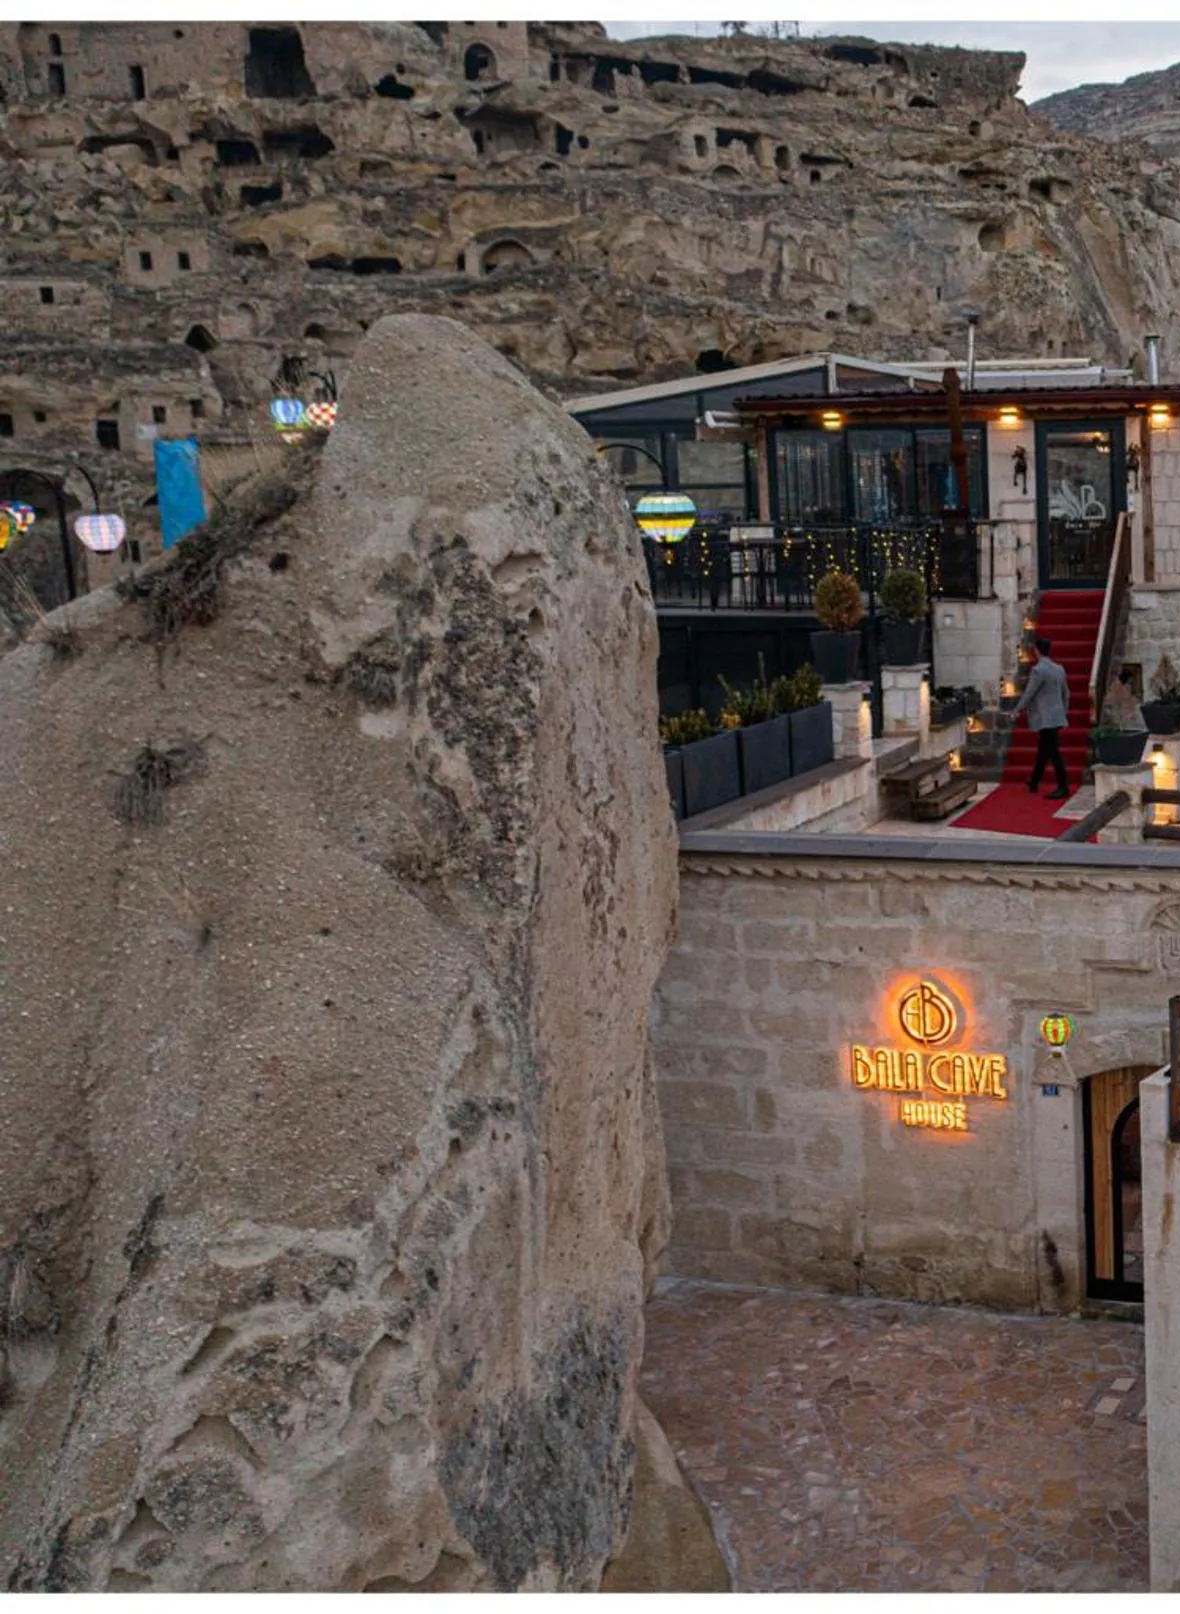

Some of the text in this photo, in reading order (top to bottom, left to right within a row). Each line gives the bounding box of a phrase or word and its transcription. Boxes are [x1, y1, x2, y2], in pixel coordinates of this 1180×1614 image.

[852, 1046, 1008, 1100] BALA CAVE
[902, 1101, 968, 1131] HOUSE
